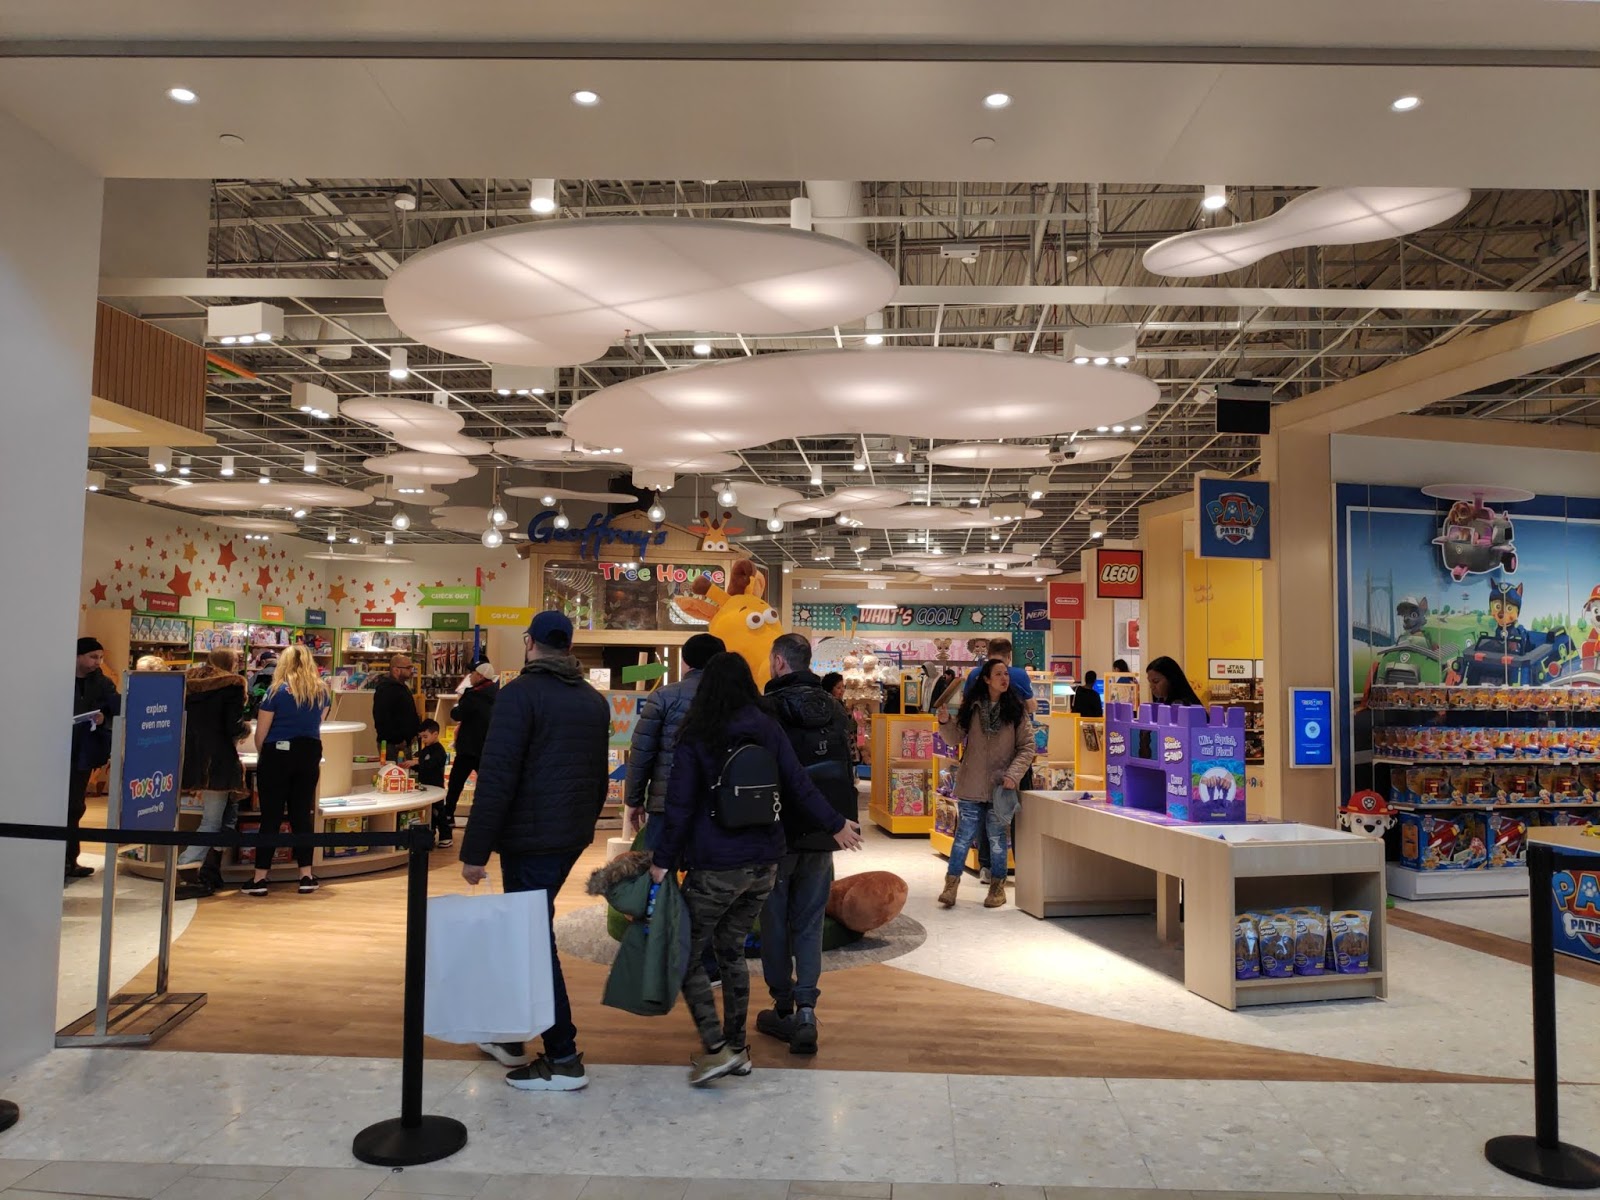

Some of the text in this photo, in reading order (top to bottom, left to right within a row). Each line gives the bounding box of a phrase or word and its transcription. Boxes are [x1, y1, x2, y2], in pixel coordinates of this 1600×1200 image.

[1206, 500, 1264, 526] PAW
[528, 511, 668, 561] Geoffrey's
[1219, 527, 1251, 536] PATROL
[599, 563, 725, 583] Tree House
[1102, 564, 1139, 583] LEGO
[860, 607, 963, 626] WHAT'S COOL!
[146, 703, 168, 716] explore
[141, 720, 171, 730] even more
